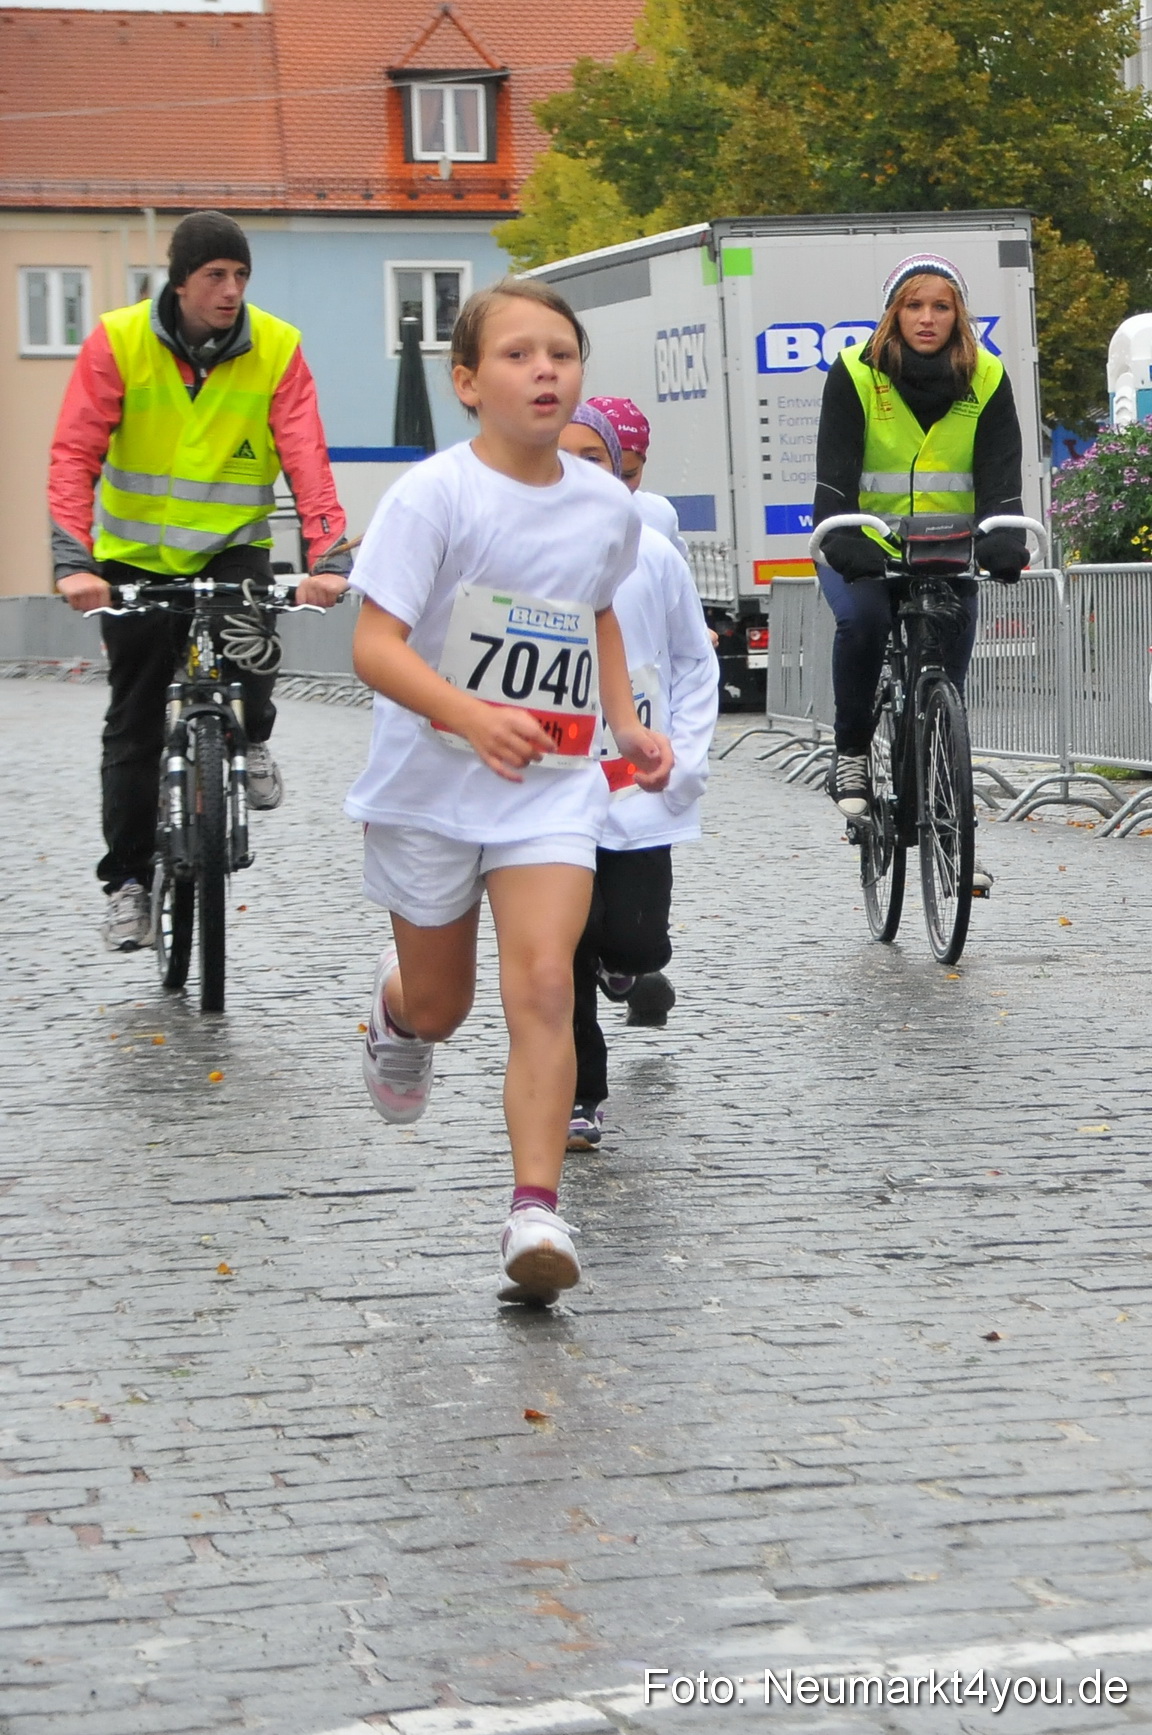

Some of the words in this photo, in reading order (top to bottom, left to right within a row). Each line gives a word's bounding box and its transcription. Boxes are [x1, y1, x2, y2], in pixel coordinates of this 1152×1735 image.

[655, 323, 708, 402] BOCK
[756, 316, 1002, 374] BOK
[508, 606, 580, 631] BOCK
[466, 632, 592, 708] 7040
